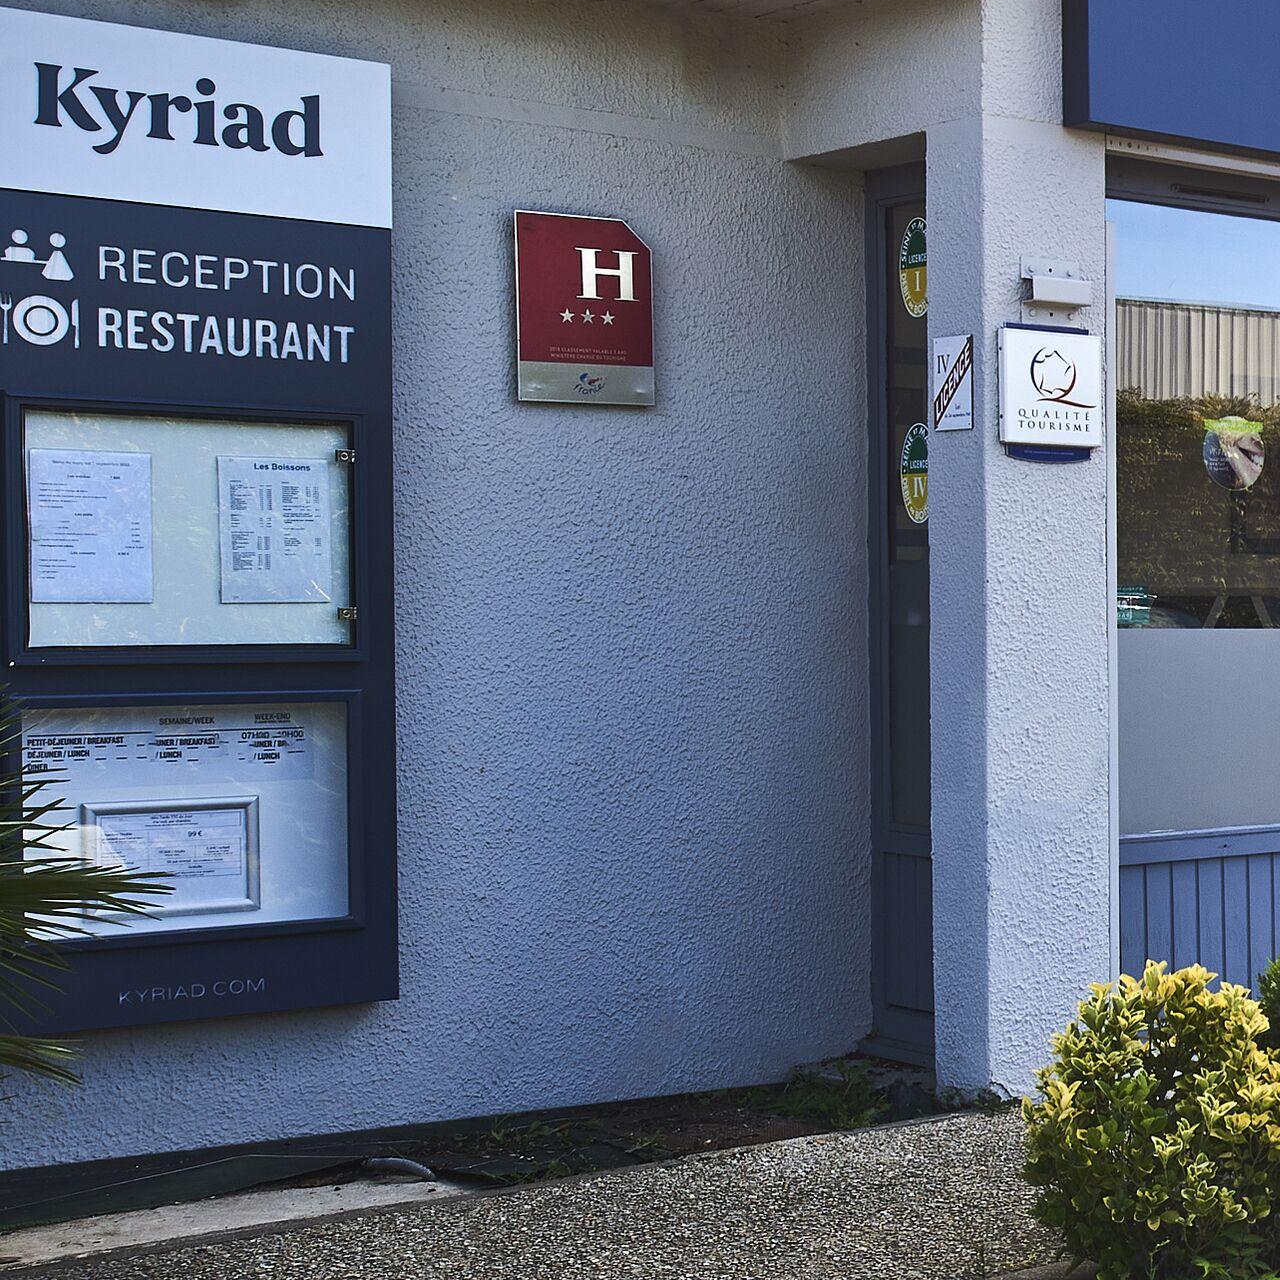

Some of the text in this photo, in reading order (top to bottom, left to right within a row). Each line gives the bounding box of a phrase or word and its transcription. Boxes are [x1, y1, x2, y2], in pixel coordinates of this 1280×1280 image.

[33, 61, 324, 158] Kyriad
[99, 245, 355, 302] RECEPTION
[575, 247, 640, 302] H
[98, 306, 355, 364] RESTAURANT
[937, 354, 950, 374] IV
[935, 342, 970, 422] LICENCE
[1018, 408, 1090, 421] QUALITÉ
[1018, 420, 1090, 432] TOURISME
[272, 463, 311, 471] Boissons
[254, 712, 291, 721] WEEK-END
[87, 736, 125, 745] BREAKFAST
[179, 737, 216, 746] BREAKFAST
[27, 749, 63, 759] DÉJEUNER
[67, 750, 90, 758] LUNCH
[159, 751, 182, 759] LUNCH
[257, 752, 281, 760] LUNCH
